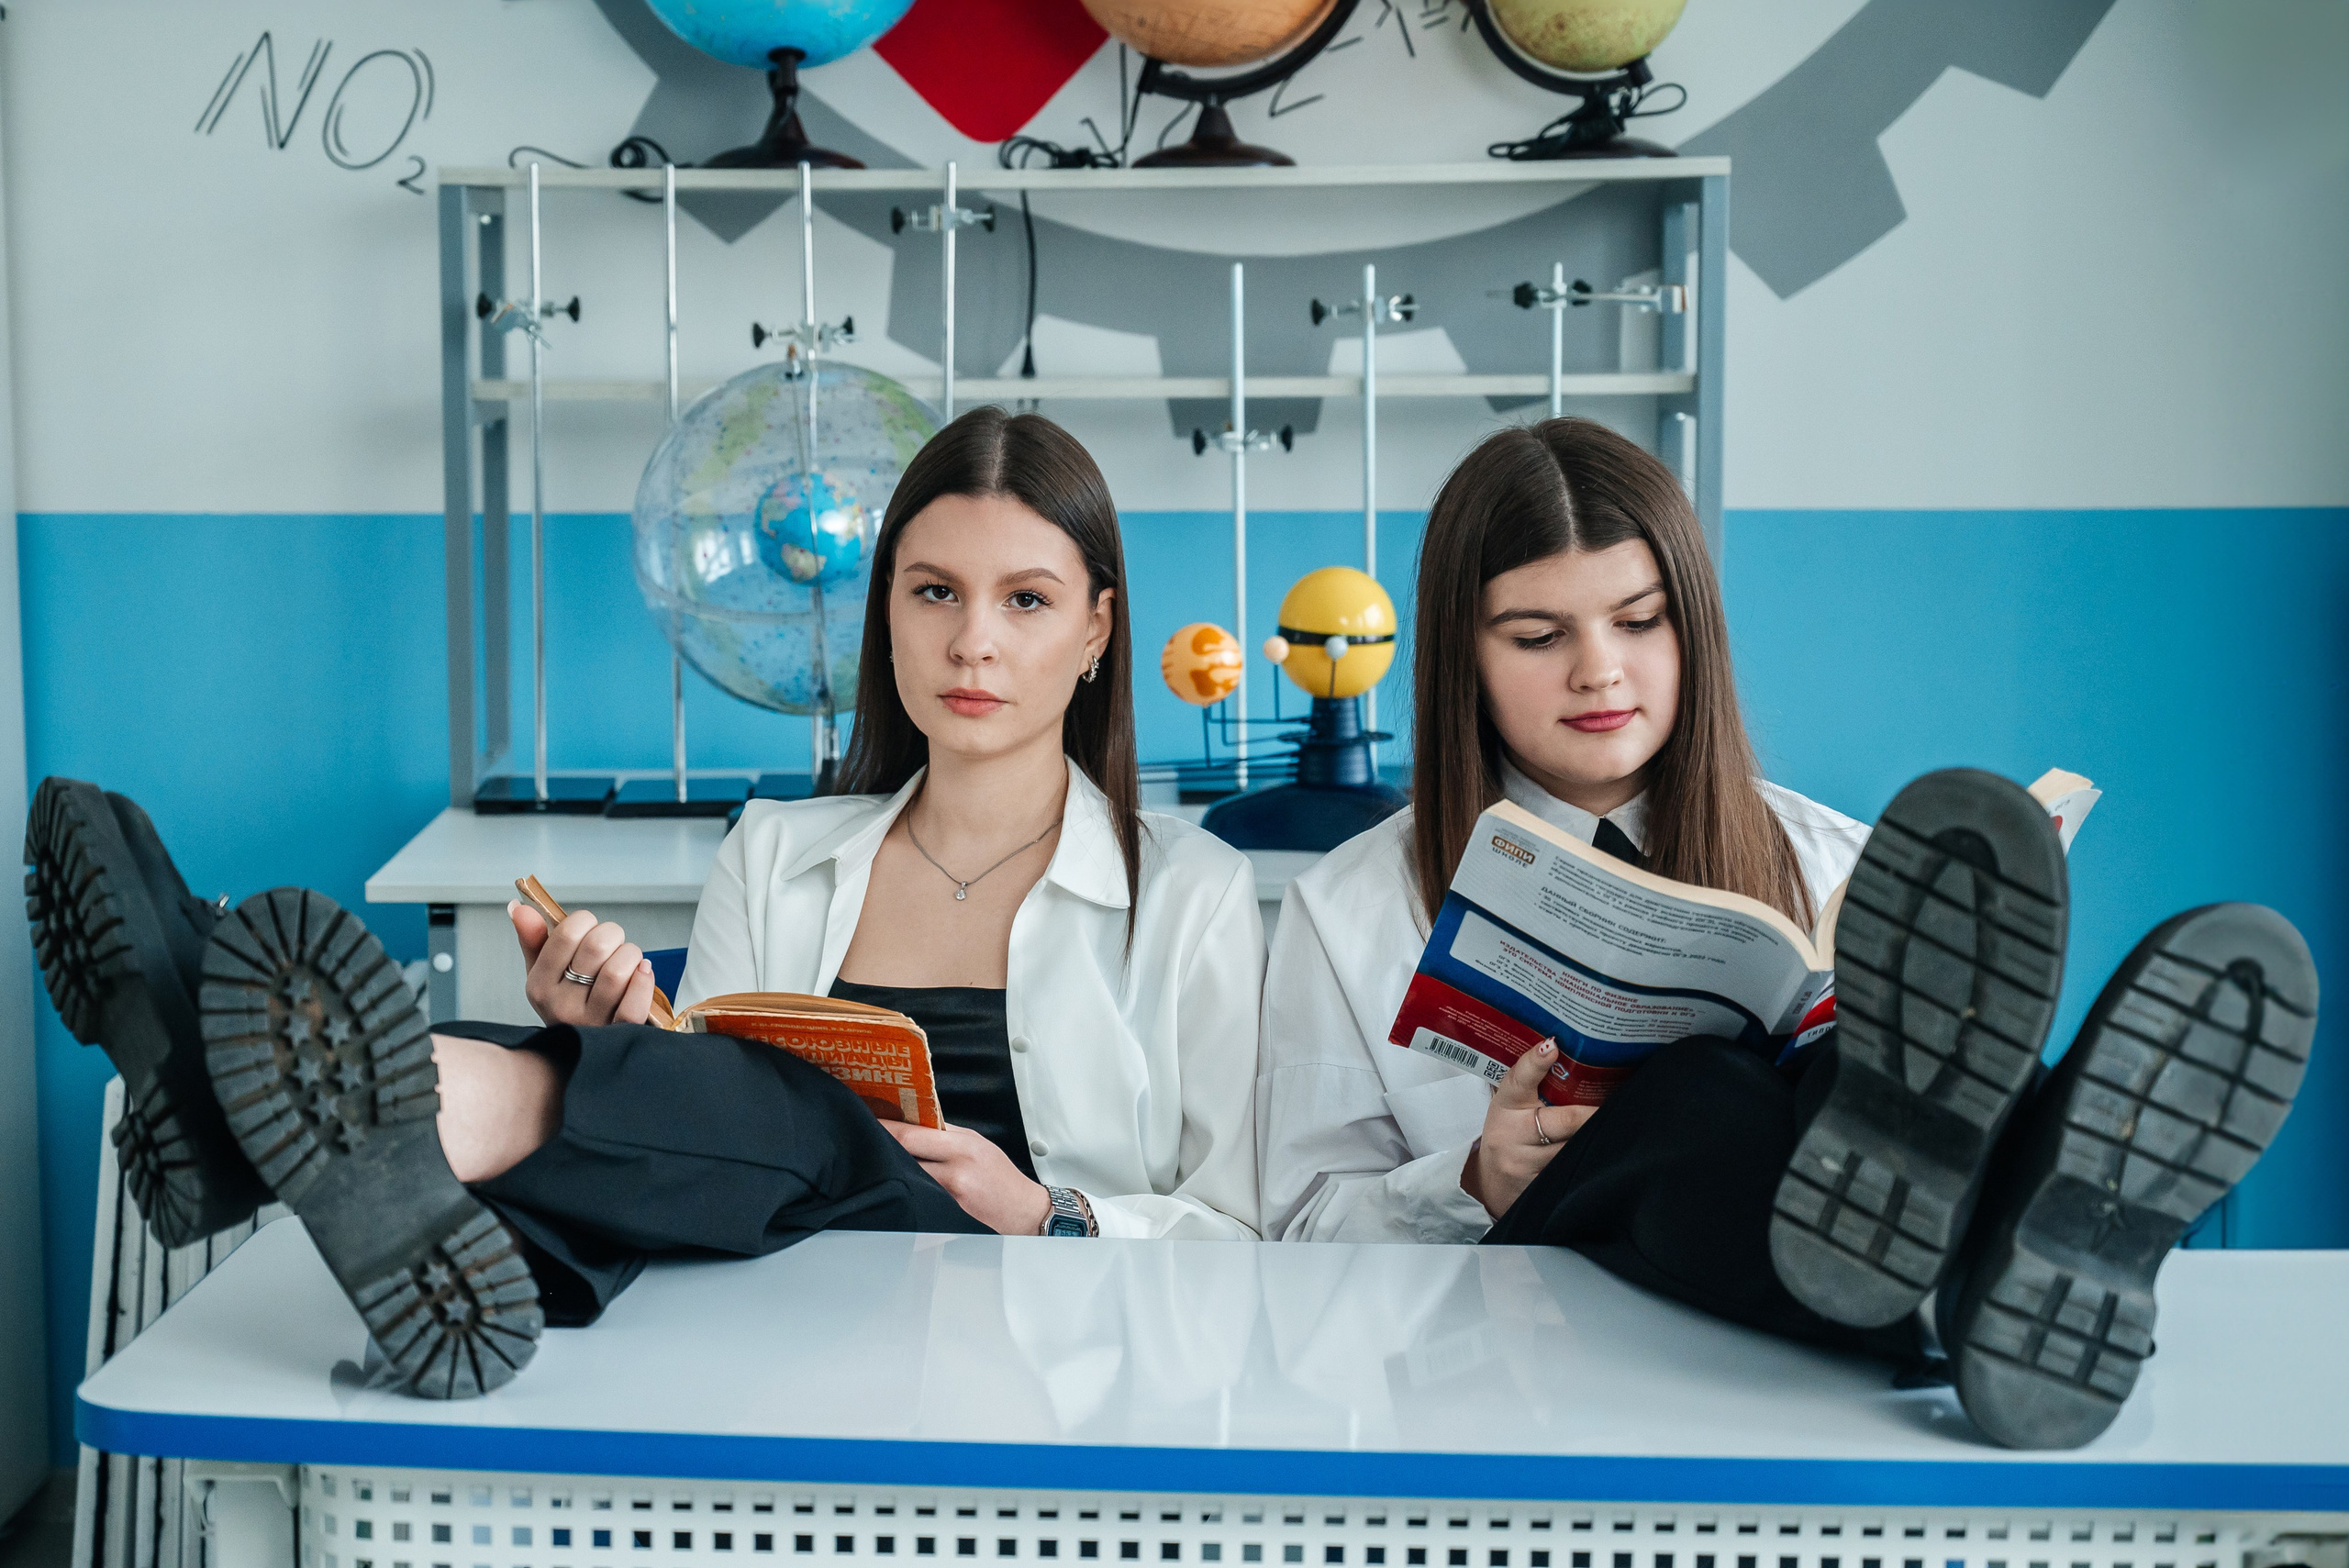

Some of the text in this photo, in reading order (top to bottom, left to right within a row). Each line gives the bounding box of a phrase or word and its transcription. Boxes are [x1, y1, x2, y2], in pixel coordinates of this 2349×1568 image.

[1492, 847, 1528, 868] ШКОЛЕ
[1494, 838, 1533, 863] ФИПИ
[1542, 886, 1576, 908] ДАННЫЙ
[1579, 906, 1616, 927] СБОРНИК
[1499, 940, 1557, 976] ИЗДАТЕЛЬСТВА
[1502, 947, 1518, 958] ЭТО
[1519, 956, 1553, 980] СИСТЕМА
[1554, 979, 1612, 1008] КОМПЛЕКСНОЙ
[1615, 1006, 1668, 1016] ПОДГОТОВКИ
[1563, 971, 1588, 987] КНИГИ
[1604, 991, 1639, 1004] ФИЗИКЕ
